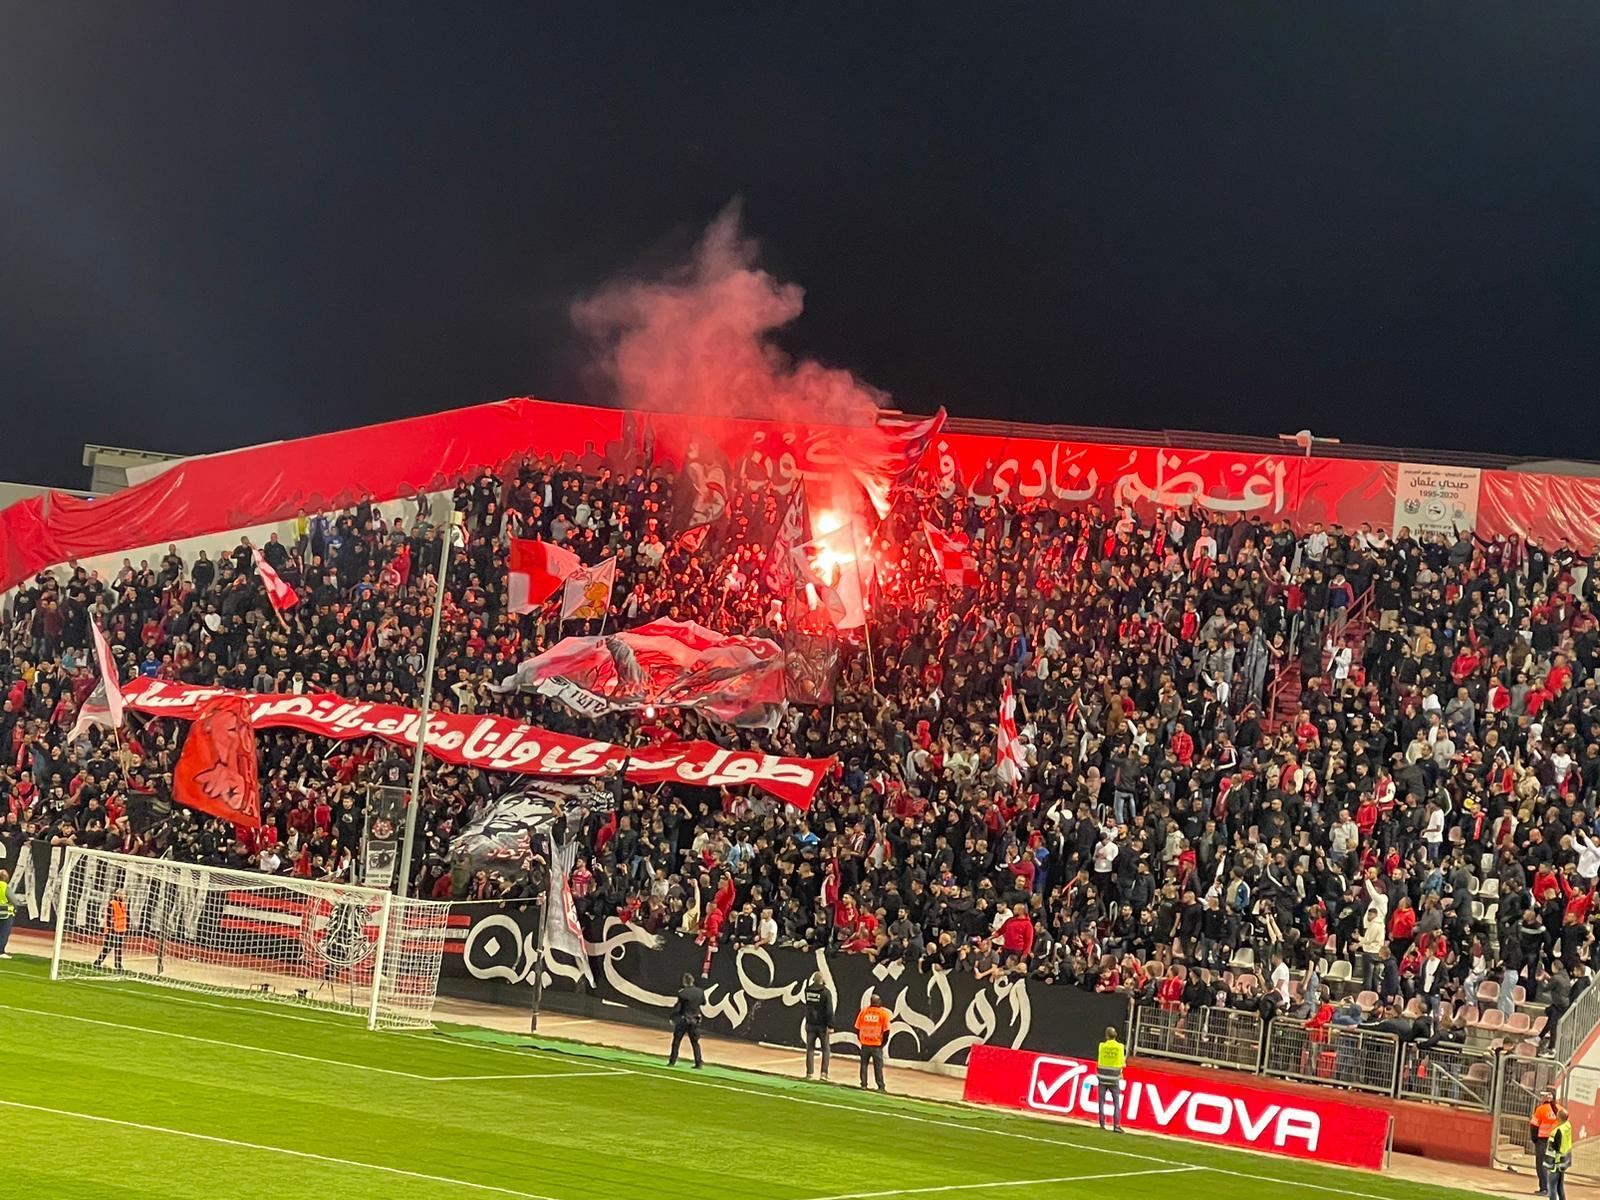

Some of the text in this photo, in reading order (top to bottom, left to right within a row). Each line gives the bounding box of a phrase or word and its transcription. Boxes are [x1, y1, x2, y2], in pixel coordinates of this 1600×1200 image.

[462, 718, 541, 768] وأنا
[676, 750, 814, 787] طول
[1080, 1074, 1320, 1152] GIVOVA
